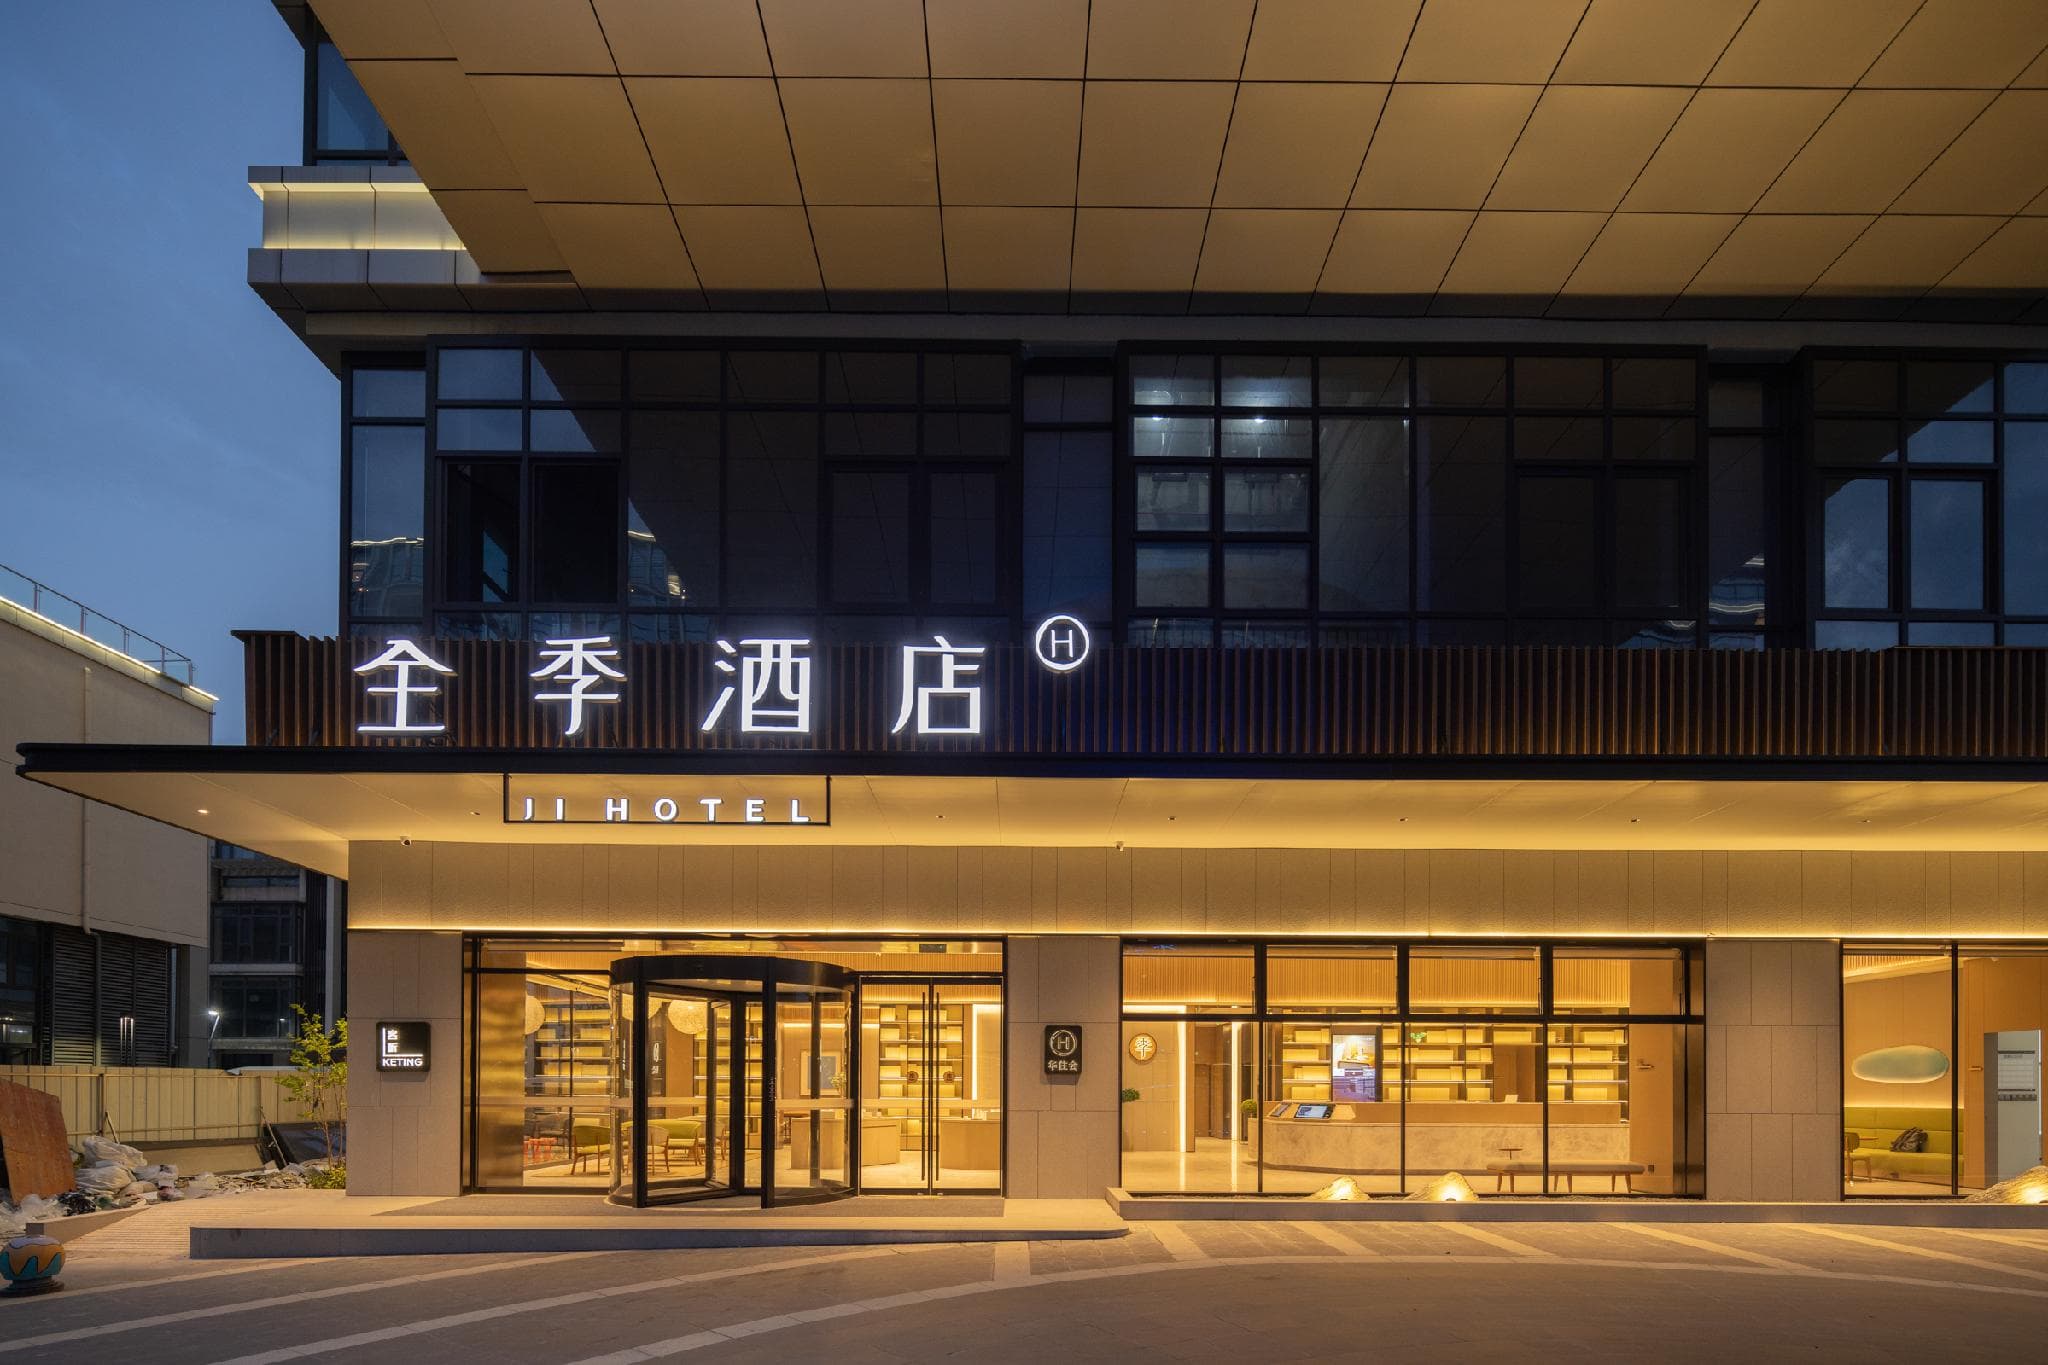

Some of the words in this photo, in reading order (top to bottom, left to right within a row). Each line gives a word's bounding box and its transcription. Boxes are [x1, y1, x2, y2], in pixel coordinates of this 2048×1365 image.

[353, 634, 986, 736] 全季酒店
[523, 797, 565, 822] JI
[605, 797, 811, 823] HOTEL
[382, 1058, 423, 1067] KETING
[1047, 1060, 1078, 1072] 华住会
